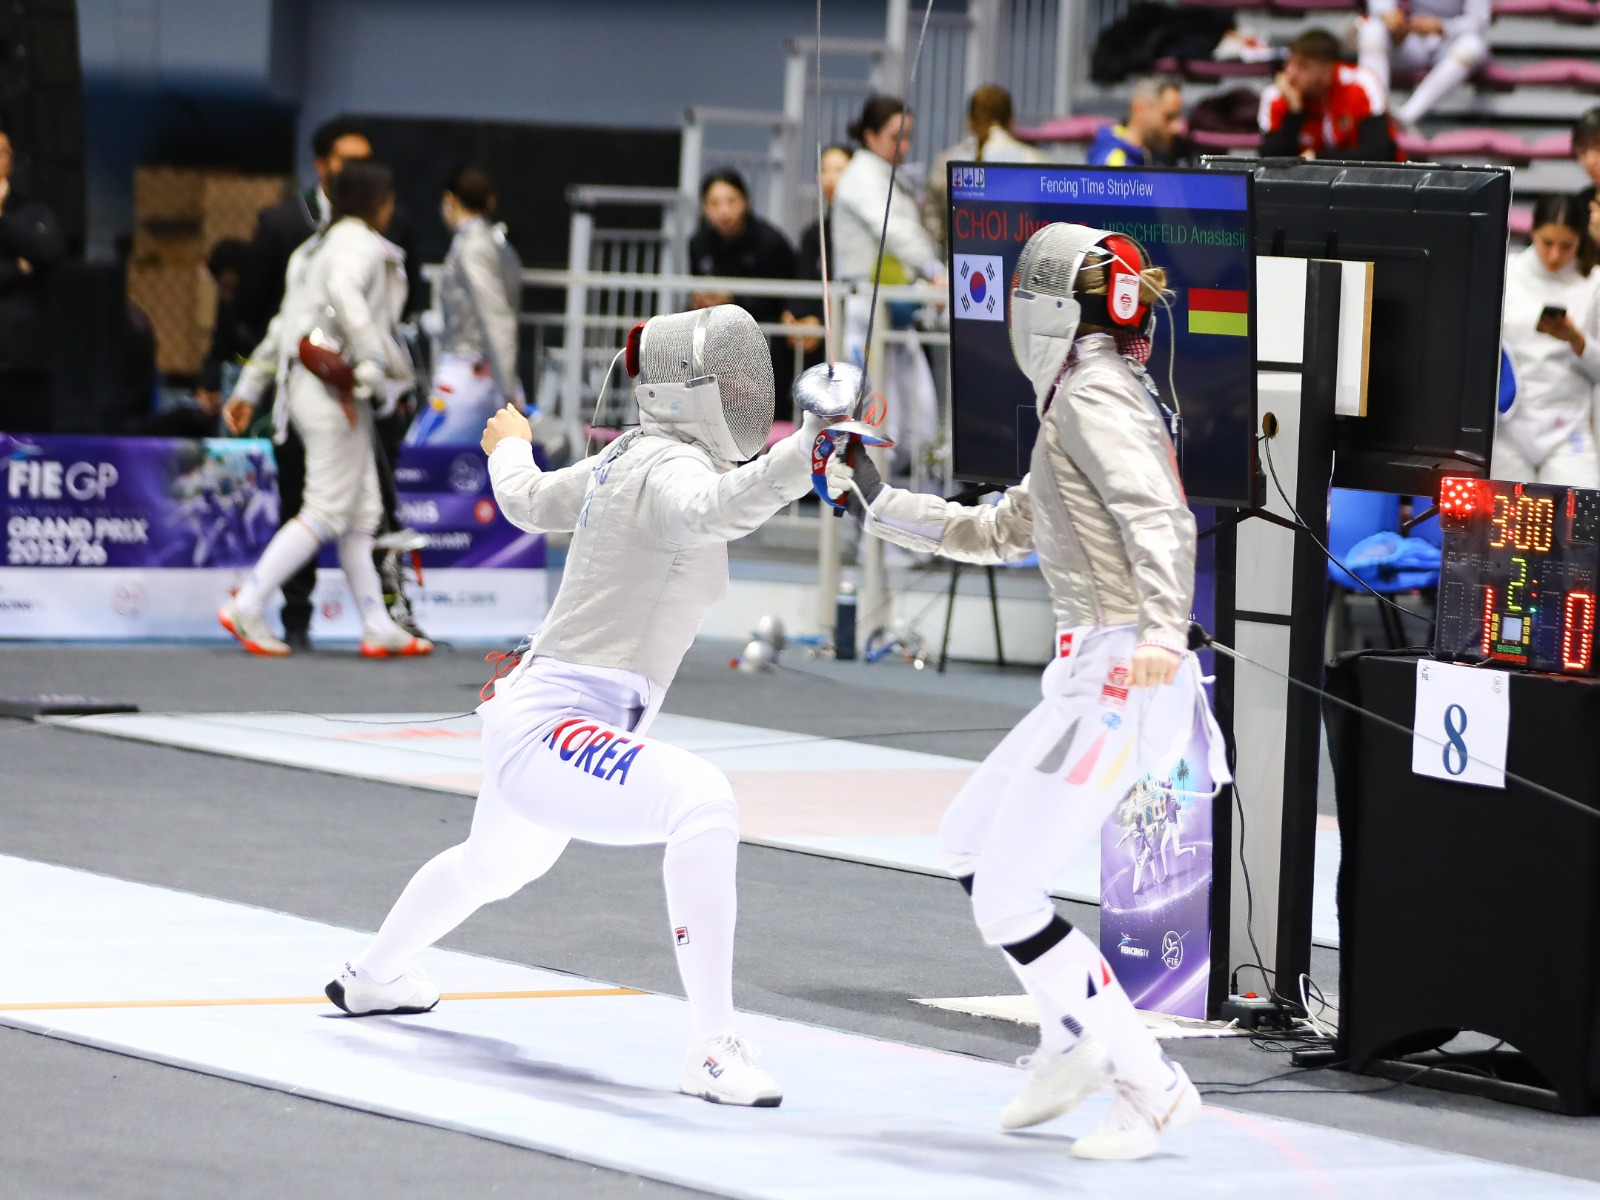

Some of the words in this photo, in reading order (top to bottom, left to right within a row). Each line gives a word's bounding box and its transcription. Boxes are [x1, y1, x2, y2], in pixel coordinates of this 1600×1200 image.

[1040, 176, 1078, 197] Fencing
[1080, 177, 1104, 194] Time
[1107, 178, 1153, 199] StripView
[955, 208, 1008, 241] CHOI
[1191, 225, 1246, 251] Anastasij
[8, 460, 63, 499] FIE
[7, 516, 94, 541] GRAND
[94, 517, 149, 544] PRIX
[1490, 495, 1553, 552] 3:00
[1507, 557, 1527, 610] 2
[1563, 592, 1591, 669] 0
[542, 718, 646, 786] KOREA
[1442, 703, 1468, 776] 8
[703, 1055, 724, 1079] FILA
